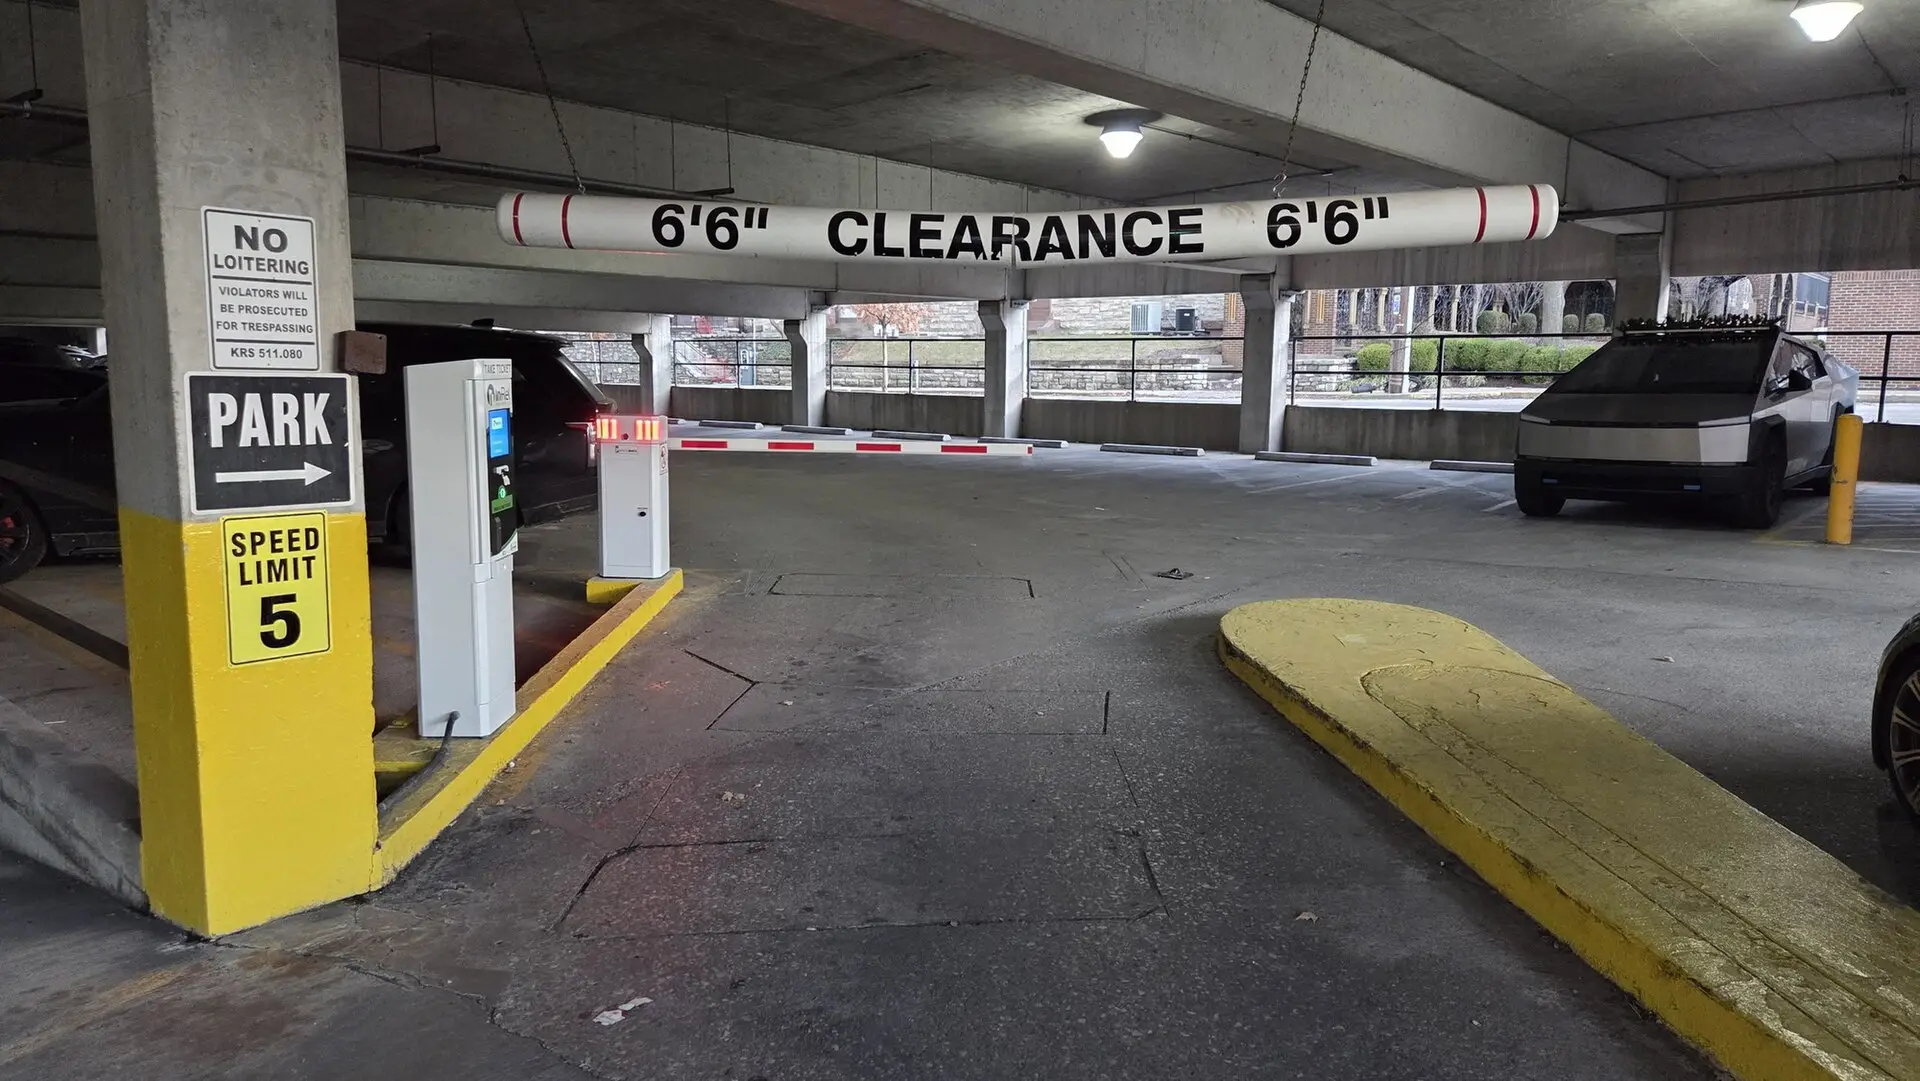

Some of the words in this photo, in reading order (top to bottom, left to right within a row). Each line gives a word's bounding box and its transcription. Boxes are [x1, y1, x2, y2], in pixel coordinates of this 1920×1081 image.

[234, 224, 288, 253] NO
[827, 206, 1205, 262] CLEARANCE
[213, 253, 309, 275] LOITERING
[218, 286, 280, 299] VIOLATORS
[282, 290, 308, 301] WILL
[220, 303, 235, 313] BE
[238, 304, 308, 317] PROSECUTED
[216, 320, 238, 331] FOR
[241, 322, 313, 334] TRESPASSING
[231, 347, 255, 358] KRS
[258, 348, 303, 359] 511.080
[208, 392, 333, 448] PARK
[231, 527, 320, 557] SPEED
[239, 555, 316, 586] LIMIT
[259, 593, 301, 650] 5
